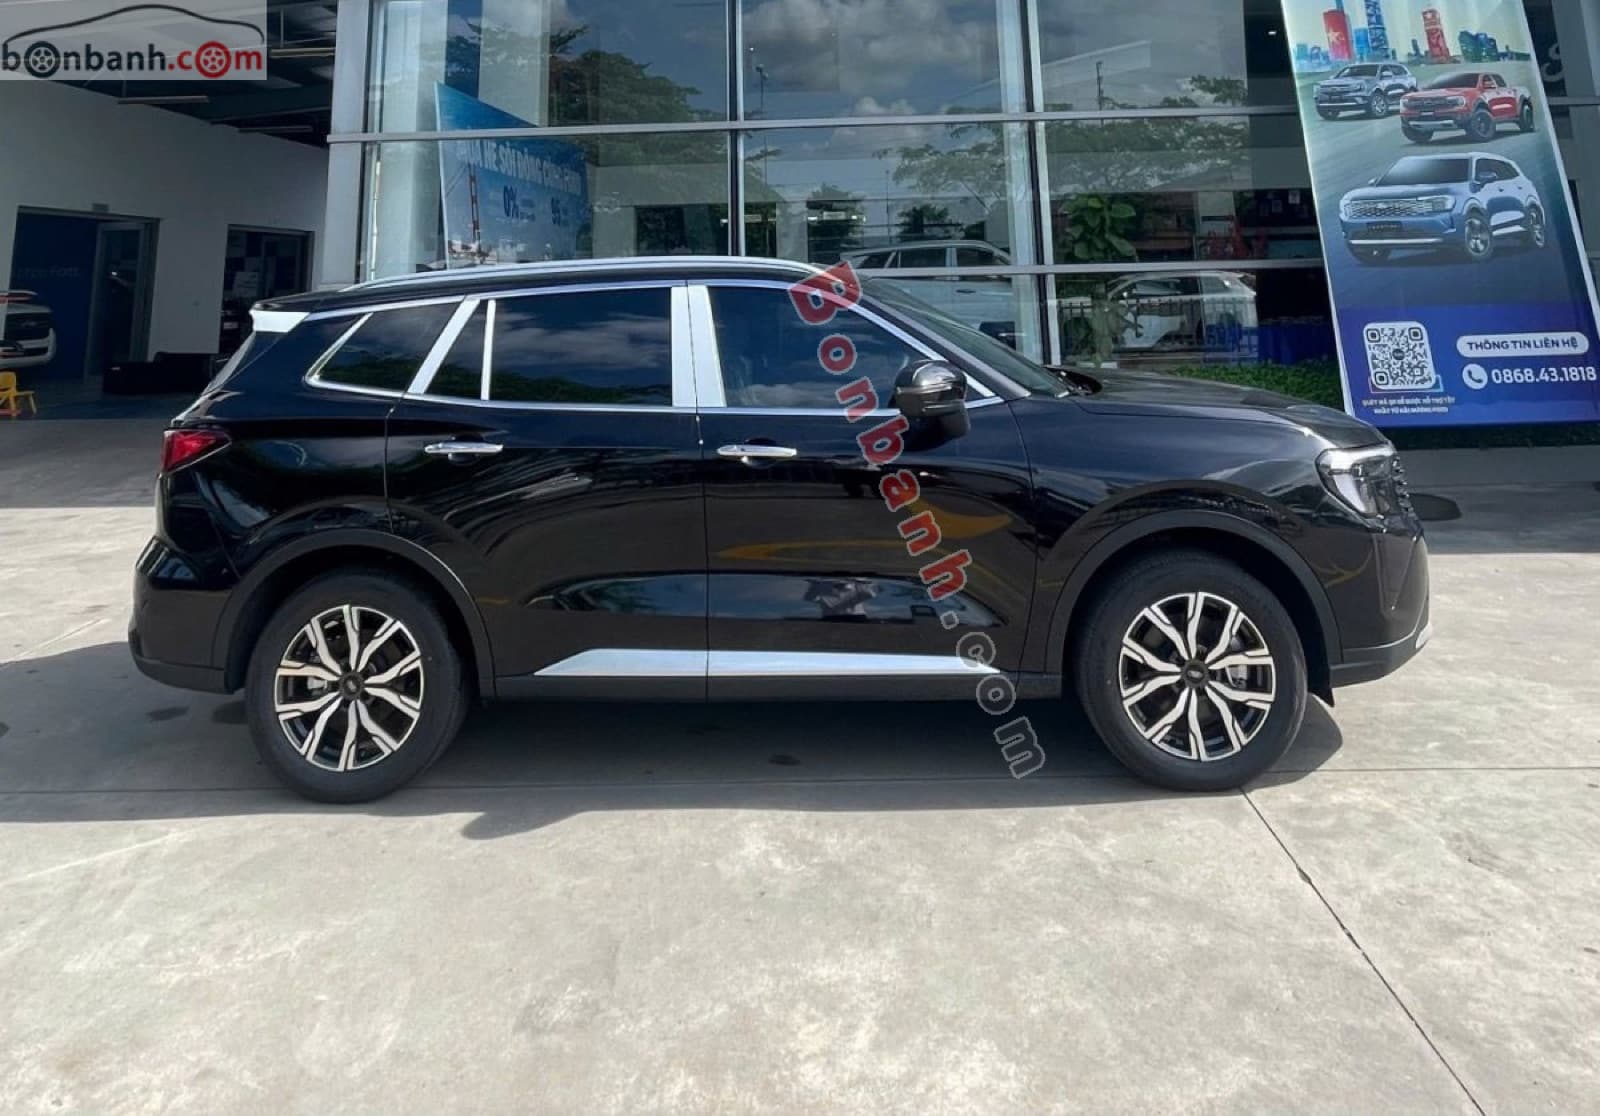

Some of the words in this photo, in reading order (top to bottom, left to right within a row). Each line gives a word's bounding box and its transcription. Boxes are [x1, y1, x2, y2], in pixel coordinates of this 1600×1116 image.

[1467, 339, 1509, 351] THÔNG
[1509, 338, 1532, 350] TIN
[1534, 336, 1560, 349] LIÊN
[1562, 335, 1579, 350] HỆ
[1491, 366, 1598, 384] 0868.43.1818
